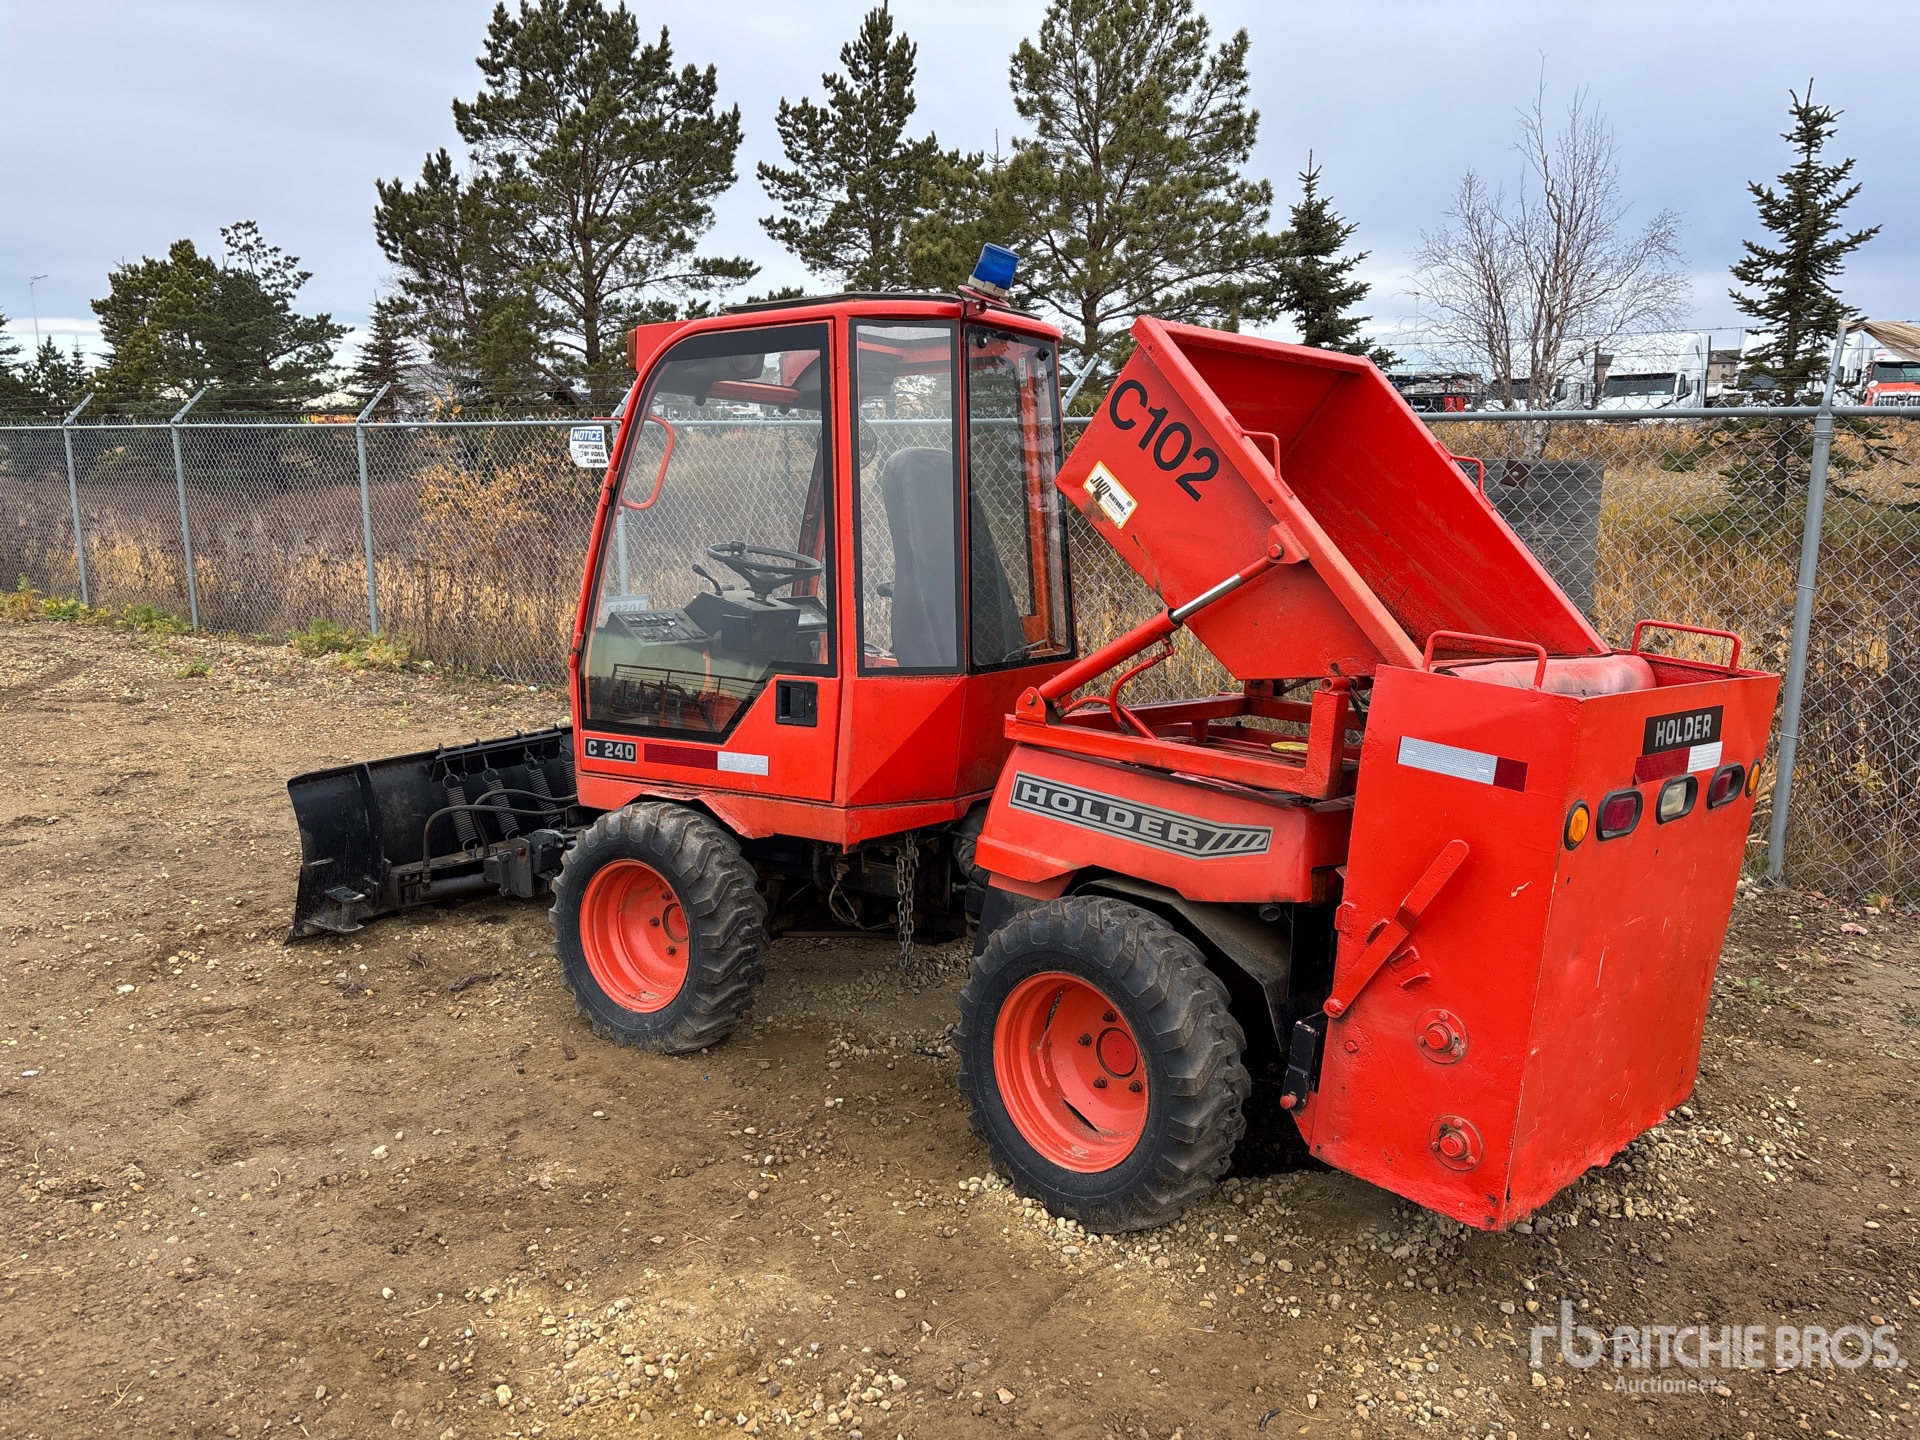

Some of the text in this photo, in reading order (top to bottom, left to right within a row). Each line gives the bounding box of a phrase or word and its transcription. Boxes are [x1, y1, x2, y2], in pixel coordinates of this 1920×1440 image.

[573, 430, 602, 441] NOTICE
[1109, 379, 1220, 502] C102
[1654, 713, 1712, 748] HOLDER
[587, 740, 635, 760] C 240
[1020, 783, 1199, 848] HOLDER
